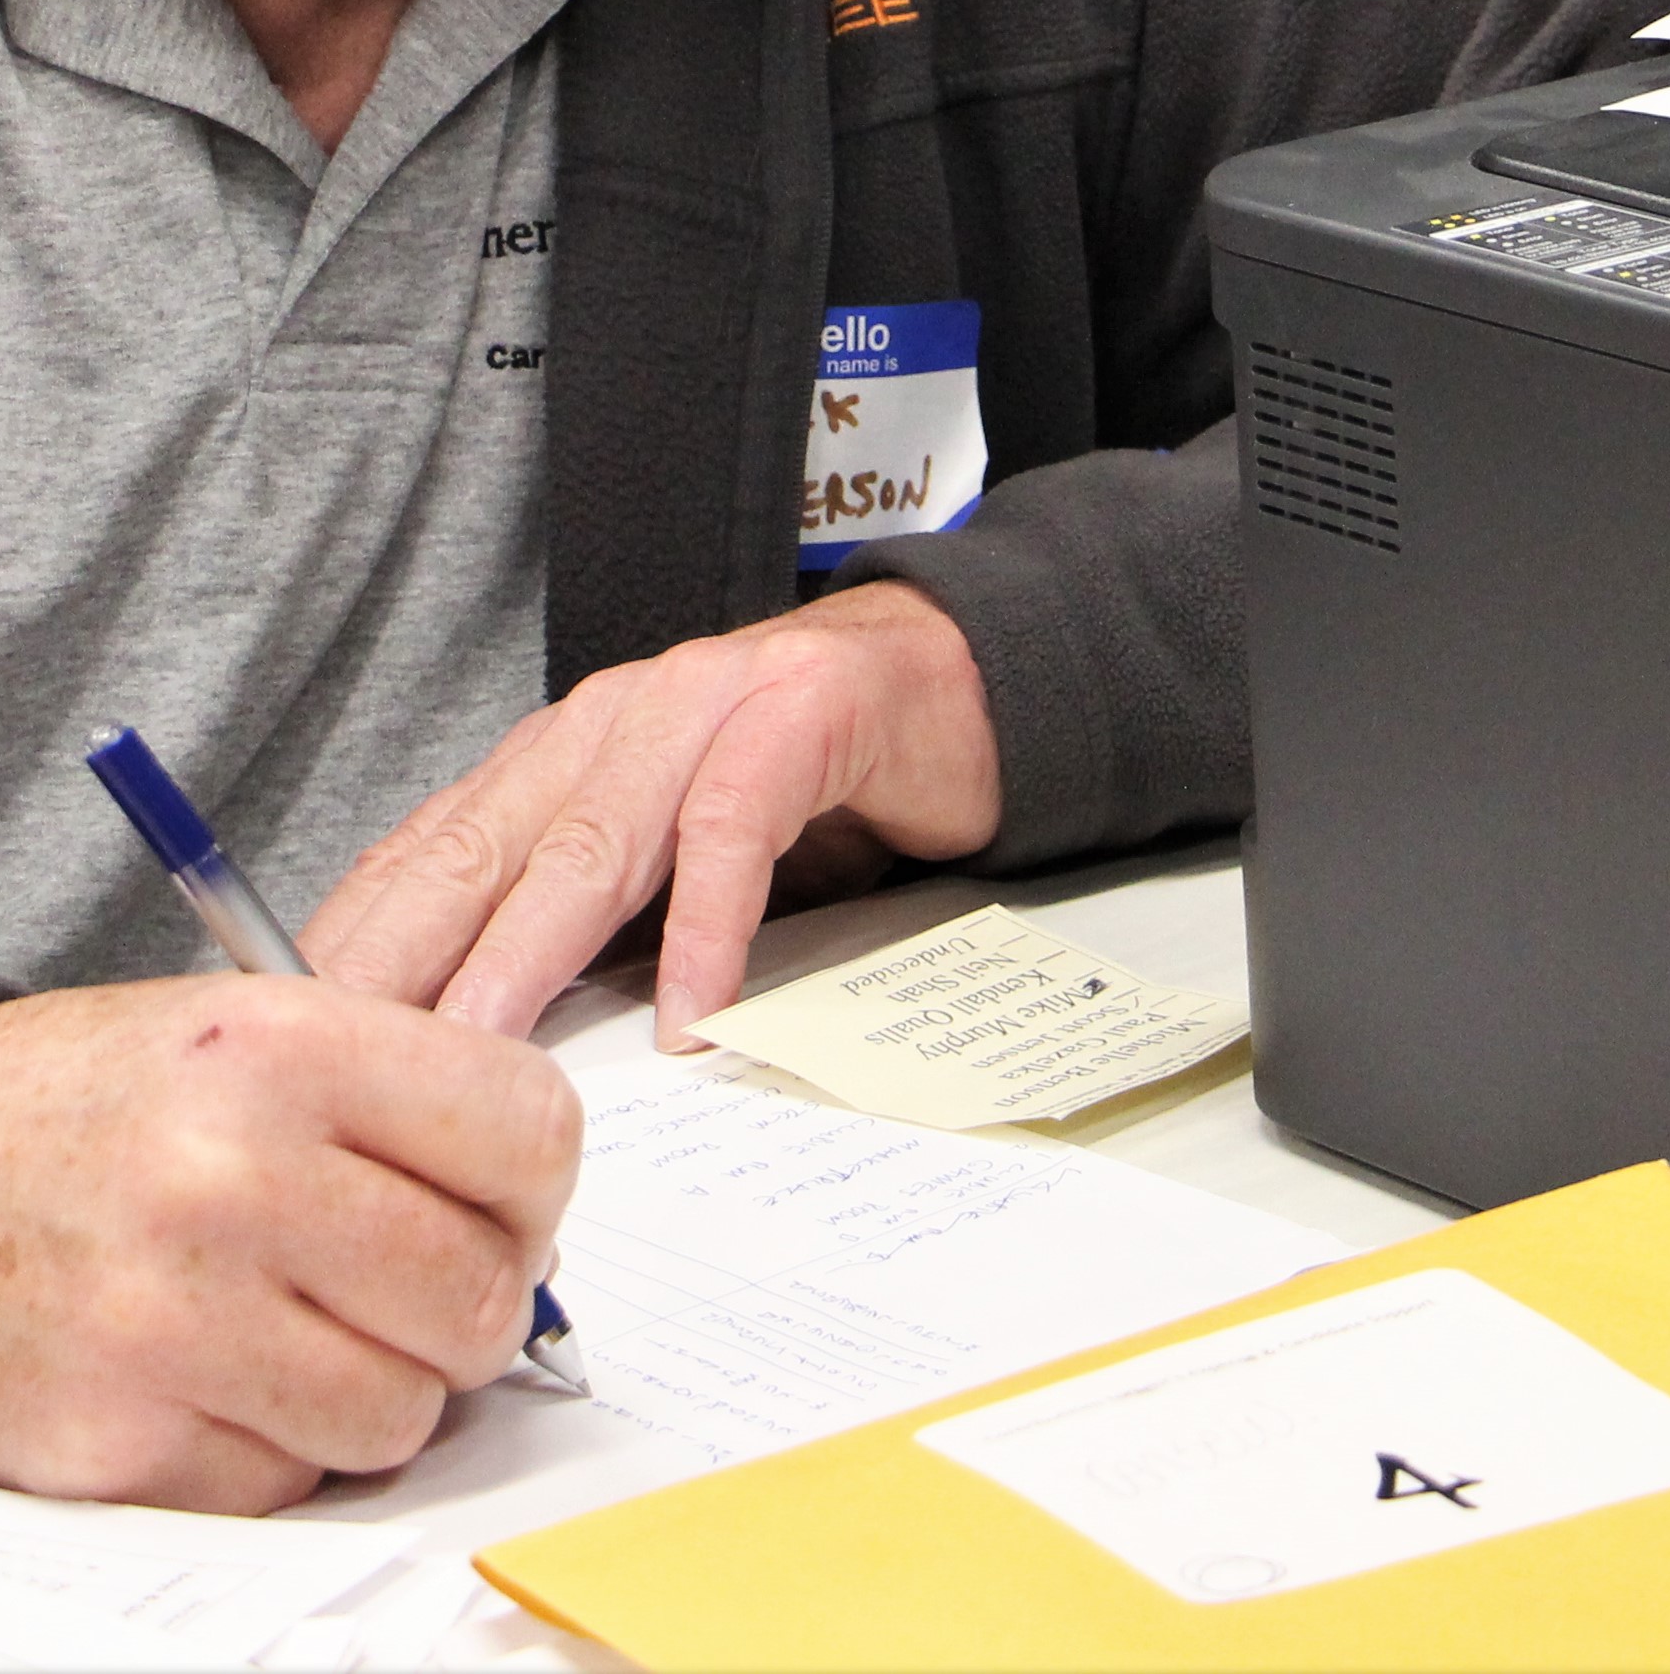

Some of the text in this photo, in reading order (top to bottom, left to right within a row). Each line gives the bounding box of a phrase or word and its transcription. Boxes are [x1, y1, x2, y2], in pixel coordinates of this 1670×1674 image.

[481, 218, 555, 259] ner
[486, 343, 545, 369] car
[820, 315, 891, 353] ello
[826, 353, 899, 373] name is
[800, 453, 932, 529] ERSON
[840, 936, 979, 996] Undecided
[887, 951, 1018, 1009] Neil Shah
[863, 969, 1055, 1047] Kendall Qualls
[915, 985, 1089, 1064] Mike Murphy
[1113, 1009, 1168, 1038] Paul
[970, 1004, 1129, 1069] Scott Jensen
[998, 1036, 1108, 1083] Gazelka
[1089, 1018, 1207, 1067] Michelle
[993, 1064, 1096, 1108] Benson
[648, 1141, 722, 1169] ROOM
[813, 1201, 890, 1226] ROOM
[1374, 1452, 1483, 1510] 4
